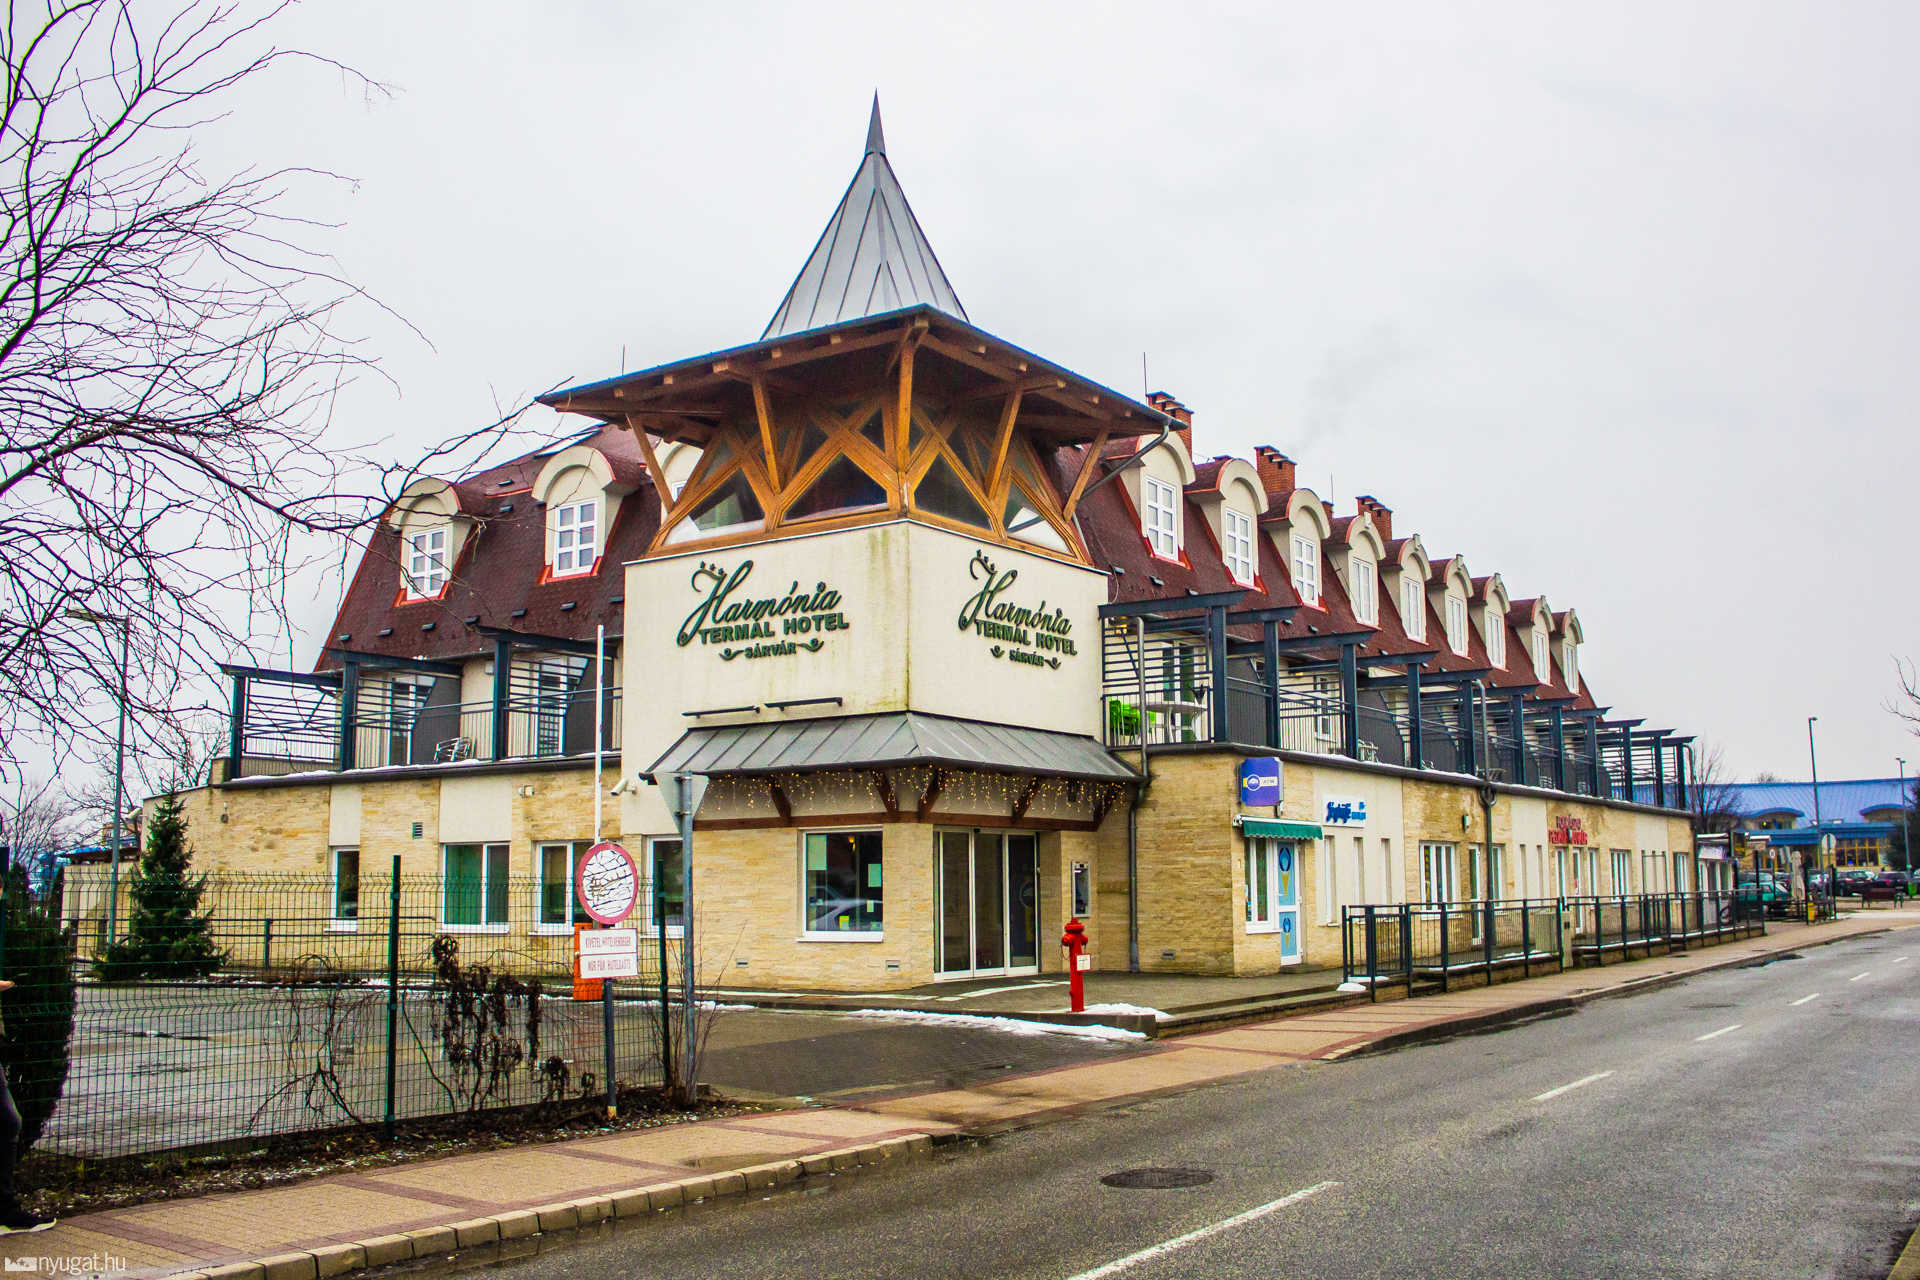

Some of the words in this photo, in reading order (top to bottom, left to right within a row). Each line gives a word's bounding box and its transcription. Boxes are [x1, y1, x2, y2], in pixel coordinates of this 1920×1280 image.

[676, 559, 842, 647] Harmónia
[958, 553, 1072, 635] Harmónia
[698, 617, 776, 645] TERMÁL
[783, 612, 850, 637] HOTEL
[974, 618, 1031, 646] TERMÁL
[1035, 631, 1078, 656] HOTEL
[744, 639, 797, 659] SÁRVÁR
[1009, 647, 1045, 667] SÁRVÁR
